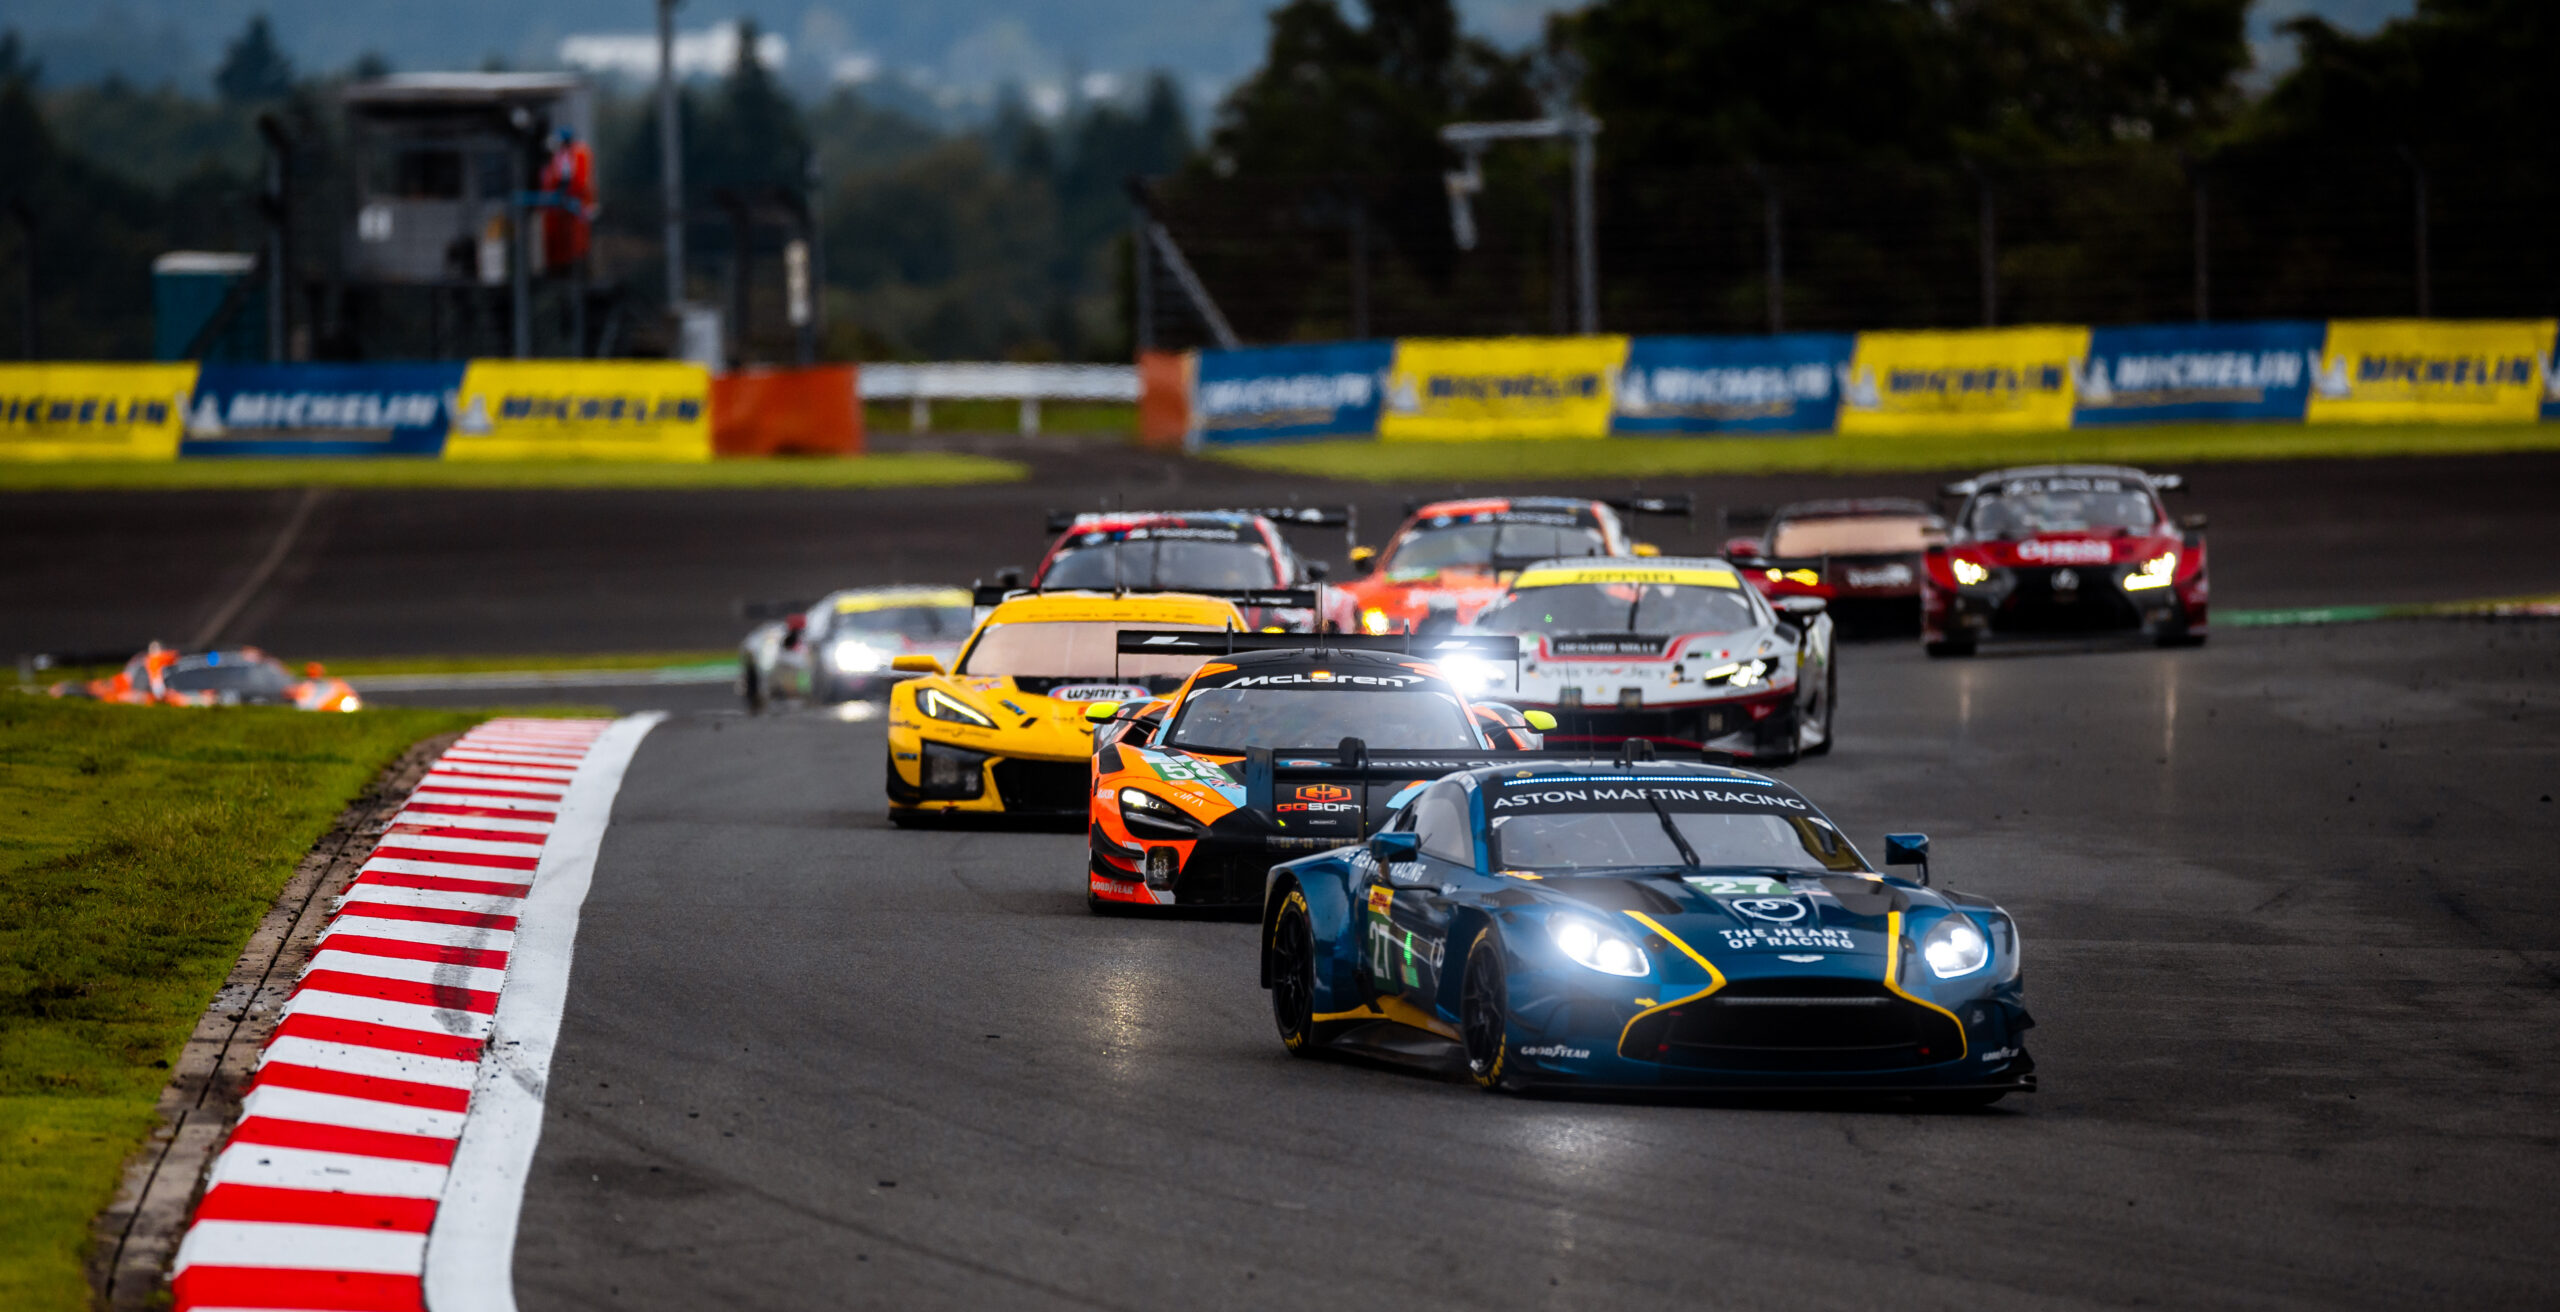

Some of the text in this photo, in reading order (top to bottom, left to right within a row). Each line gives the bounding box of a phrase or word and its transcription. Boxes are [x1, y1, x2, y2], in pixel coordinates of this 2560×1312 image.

[0, 397, 167, 424] ICHELIN
[1160, 760, 1226, 780] 58
[1367, 760, 1460, 768] eattle
[1493, 788, 1807, 810] ASTON MARTIN RACING
[1091, 881, 1135, 896] GOODYEAR
[1701, 881, 1775, 895] 27
[1719, 928, 1850, 940] THE HEART
[1369, 920, 1391, 980] 27
[1728, 937, 1855, 950] OF RACING
[1520, 1044, 1591, 1060] GOODYEAR
